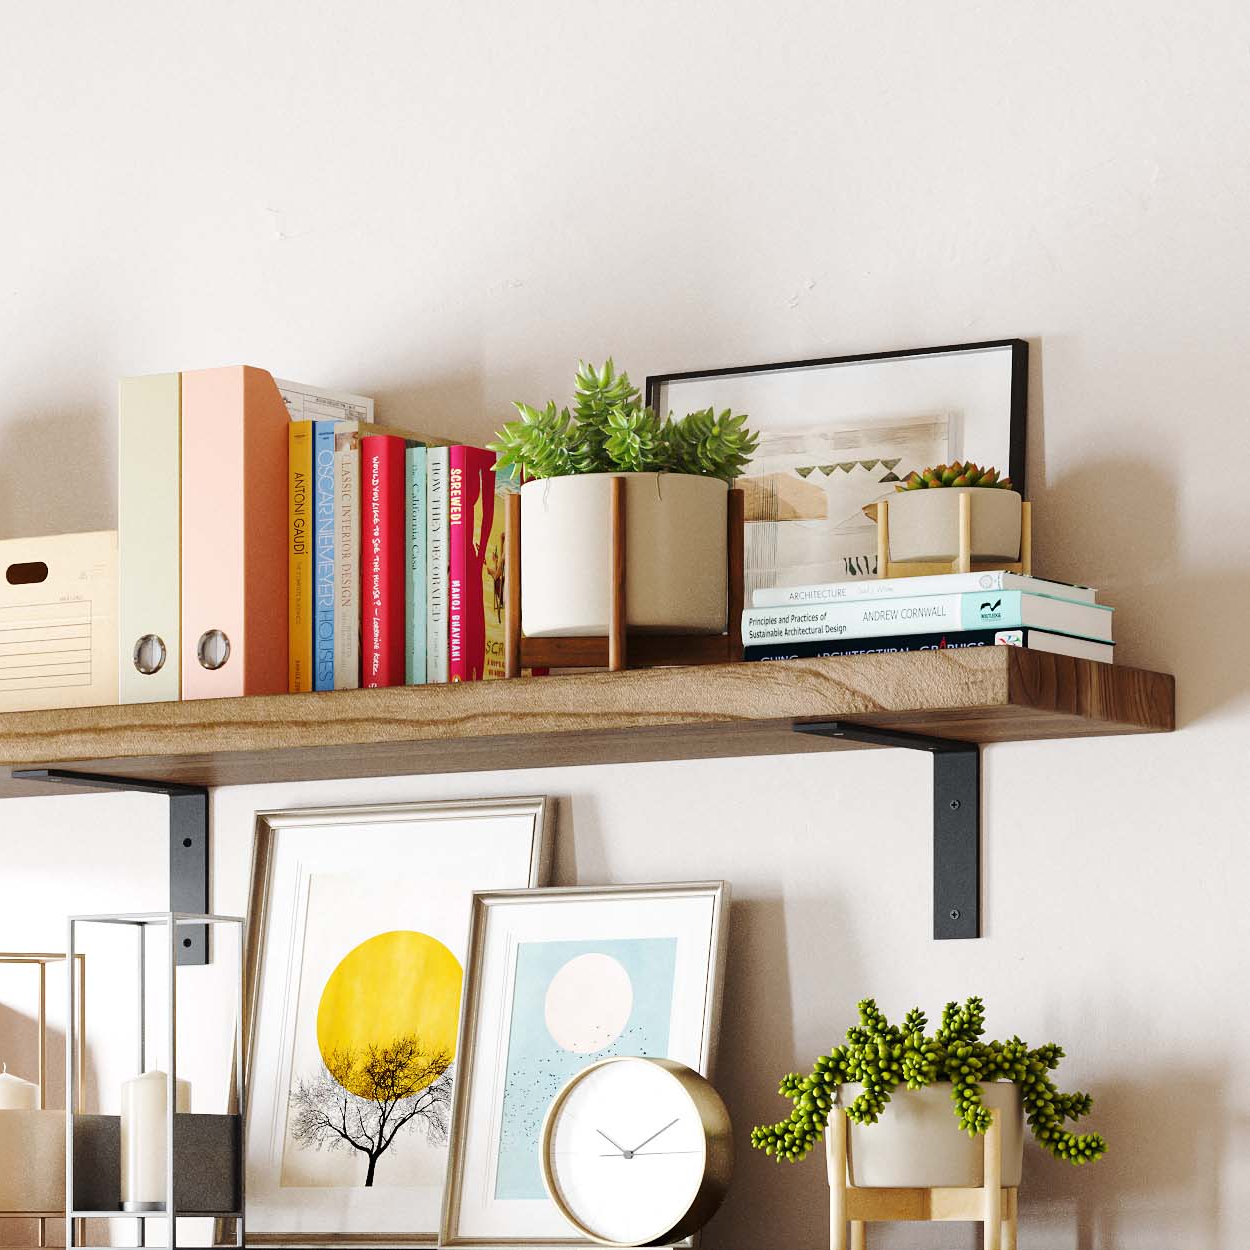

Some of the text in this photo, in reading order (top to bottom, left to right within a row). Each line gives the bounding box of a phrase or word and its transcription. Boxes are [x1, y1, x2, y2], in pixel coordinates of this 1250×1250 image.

[317, 448, 335, 515] OSCAR
[341, 454, 352, 502] CLASSIC
[371, 456, 381, 486] WOULD
[431, 462, 441, 492] HOW
[293, 472, 306, 516] ANTONI
[372, 486, 381, 501] YOU
[372, 502, 381, 525] LIKE
[412, 483, 421, 541] California
[431, 496, 441, 532] THEY
[341, 505, 352, 560] INTERIOR
[373, 526, 381, 537] TO
[317, 518, 335, 607] NIEMEYER
[373, 556, 382, 573] THE
[412, 544, 421, 571] Casa
[341, 563, 352, 608] DESIGN
[431, 539, 441, 622] DECORATED
[451, 579, 462, 611] MANOJ
[789, 588, 847, 601] ARCHITECTURE
[748, 612, 828, 627] Principles and Practices of
[862, 606, 947, 622] ANDREW CORNWALL
[318, 610, 335, 682] HOUSES
[748, 624, 847, 639] Sustainable Architectural Design
